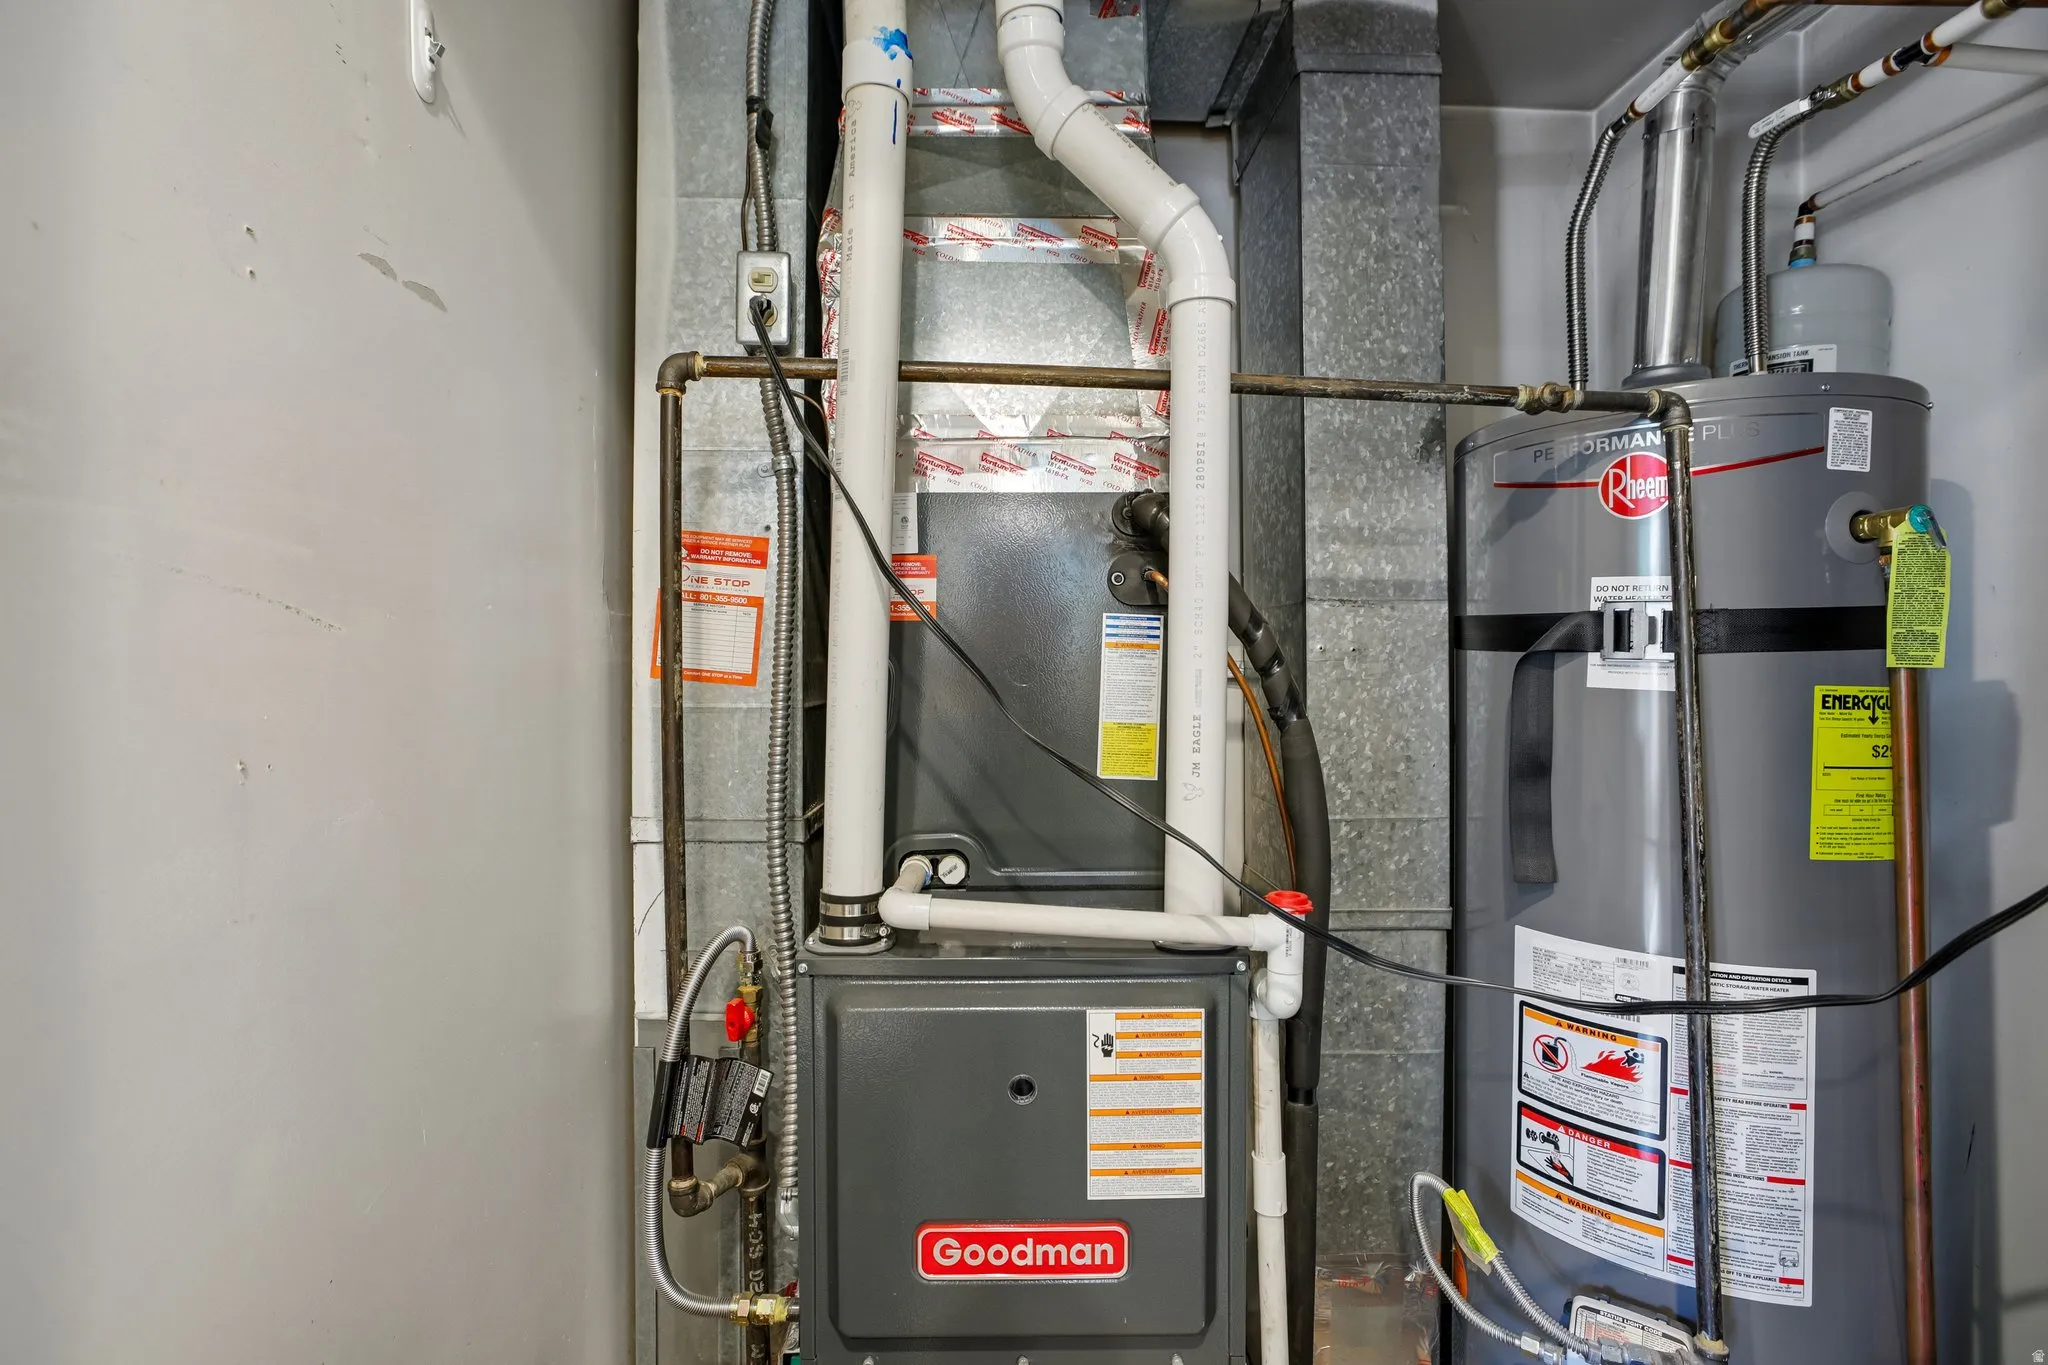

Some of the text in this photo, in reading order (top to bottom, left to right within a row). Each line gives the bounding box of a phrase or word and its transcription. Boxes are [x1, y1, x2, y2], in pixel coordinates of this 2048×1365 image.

[844, 118, 857, 261] Made in America
[946, 225, 993, 248] VentureTape
[1017, 225, 1064, 248] VentureTape
[1081, 226, 1119, 249] VentureTap
[1197, 321, 1207, 357] D2665
[1197, 365, 1207, 394] ASTM
[1007, 443, 1037, 458] WEATHER
[1533, 421, 1761, 463] PERFORMANE PLUS
[917, 454, 965, 477] VentureTape
[1050, 454, 1097, 476] VentureTape
[1113, 454, 1160, 478] VentureTape
[1196, 442, 1205, 489] 280PSI
[1608, 455, 1669, 508] Rheem
[722, 556, 761, 564] INFORMATION
[714, 577, 750, 587] STOP
[700, 593, 747, 604] 801-355-9500
[1192, 714, 1201, 754] EAGLE
[1872, 745, 1892, 758] $2
[1192, 762, 1200, 778] JM
[1566, 1022, 1618, 1042] WARNING
[1572, 1081, 1598, 1094] EXPLOSION
[1599, 1090, 1619, 1099] HAZARD
[1580, 1072, 1629, 1090] Flammable Vapors
[1568, 1129, 1611, 1149] DANGER
[1733, 1173, 1764, 1181] INSTRUCTIONS
[1567, 1197, 1612, 1220] WARNING
[932, 1237, 1114, 1266] Goodman
[1599, 1310, 1662, 1336] STATUS LIGHT CODE
